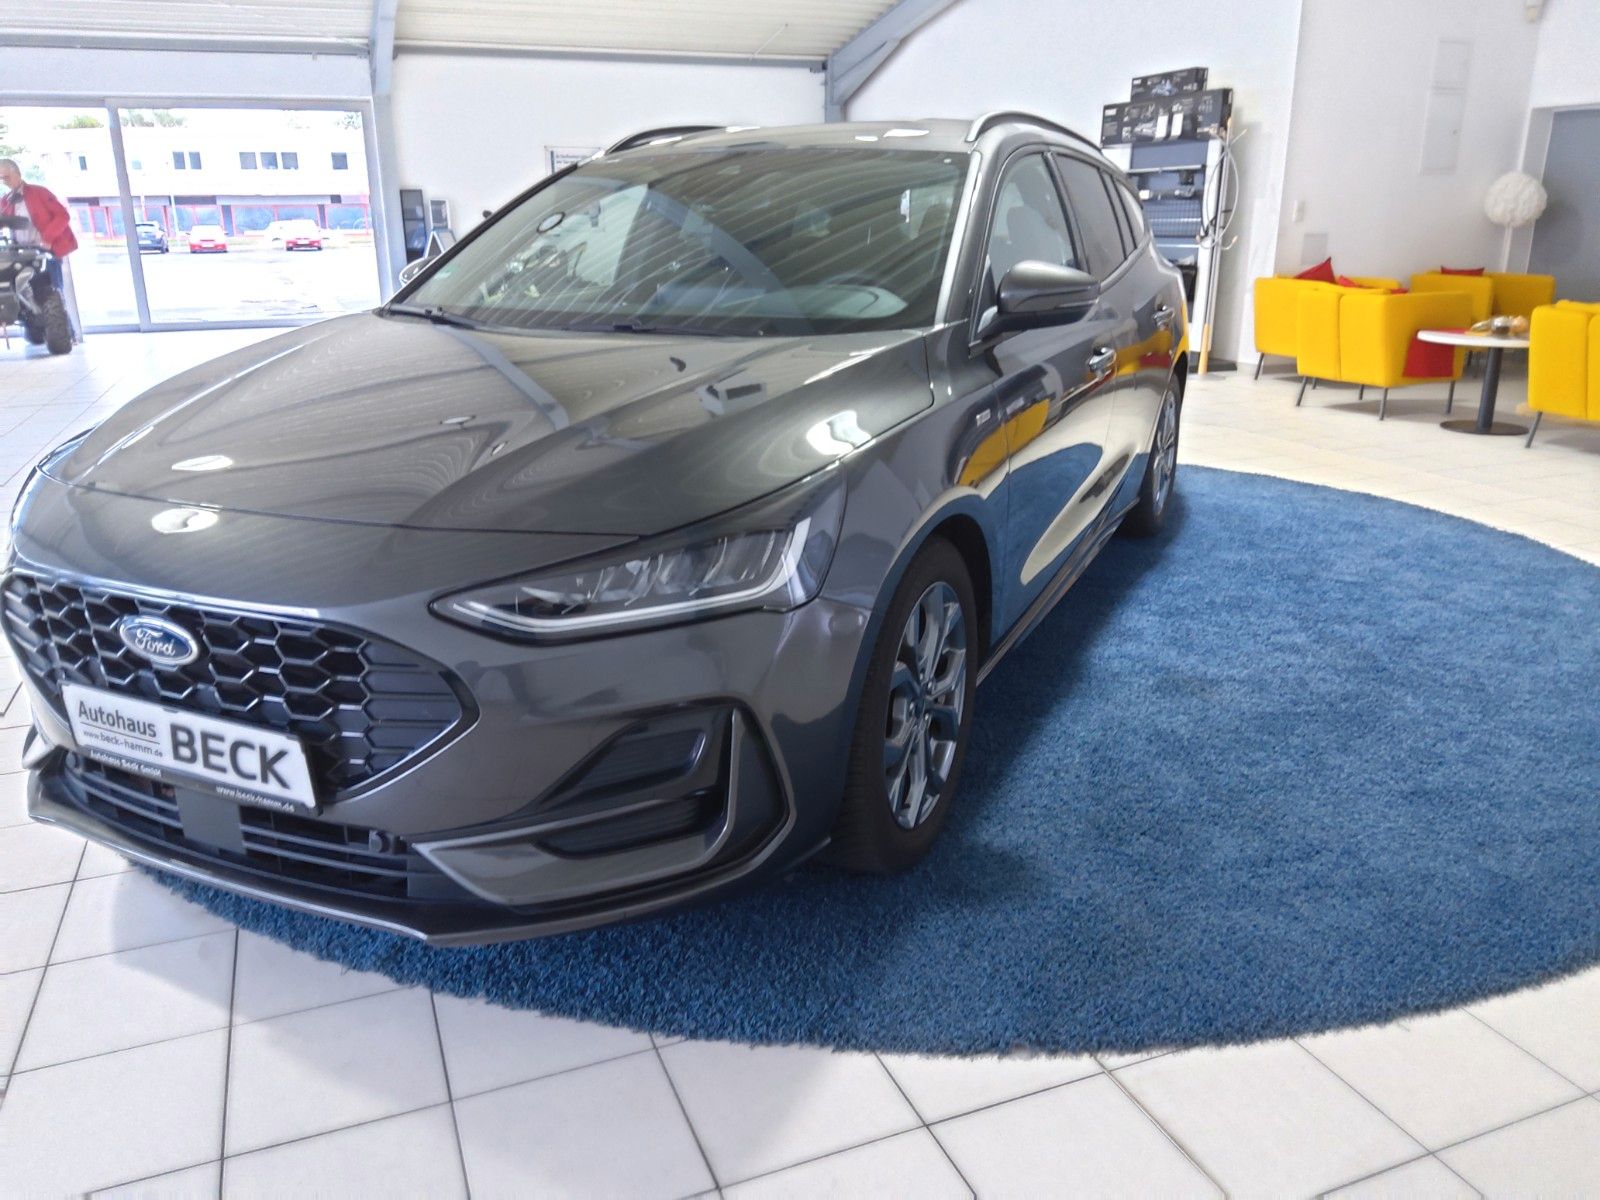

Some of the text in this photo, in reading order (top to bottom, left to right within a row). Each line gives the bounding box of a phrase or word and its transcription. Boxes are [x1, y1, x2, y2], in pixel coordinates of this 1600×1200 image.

[135, 628, 175, 656] Ford
[79, 700, 157, 738] Autohaus
[83, 730, 163, 757] www.beck-hamm.de
[170, 724, 291, 790] BECK
